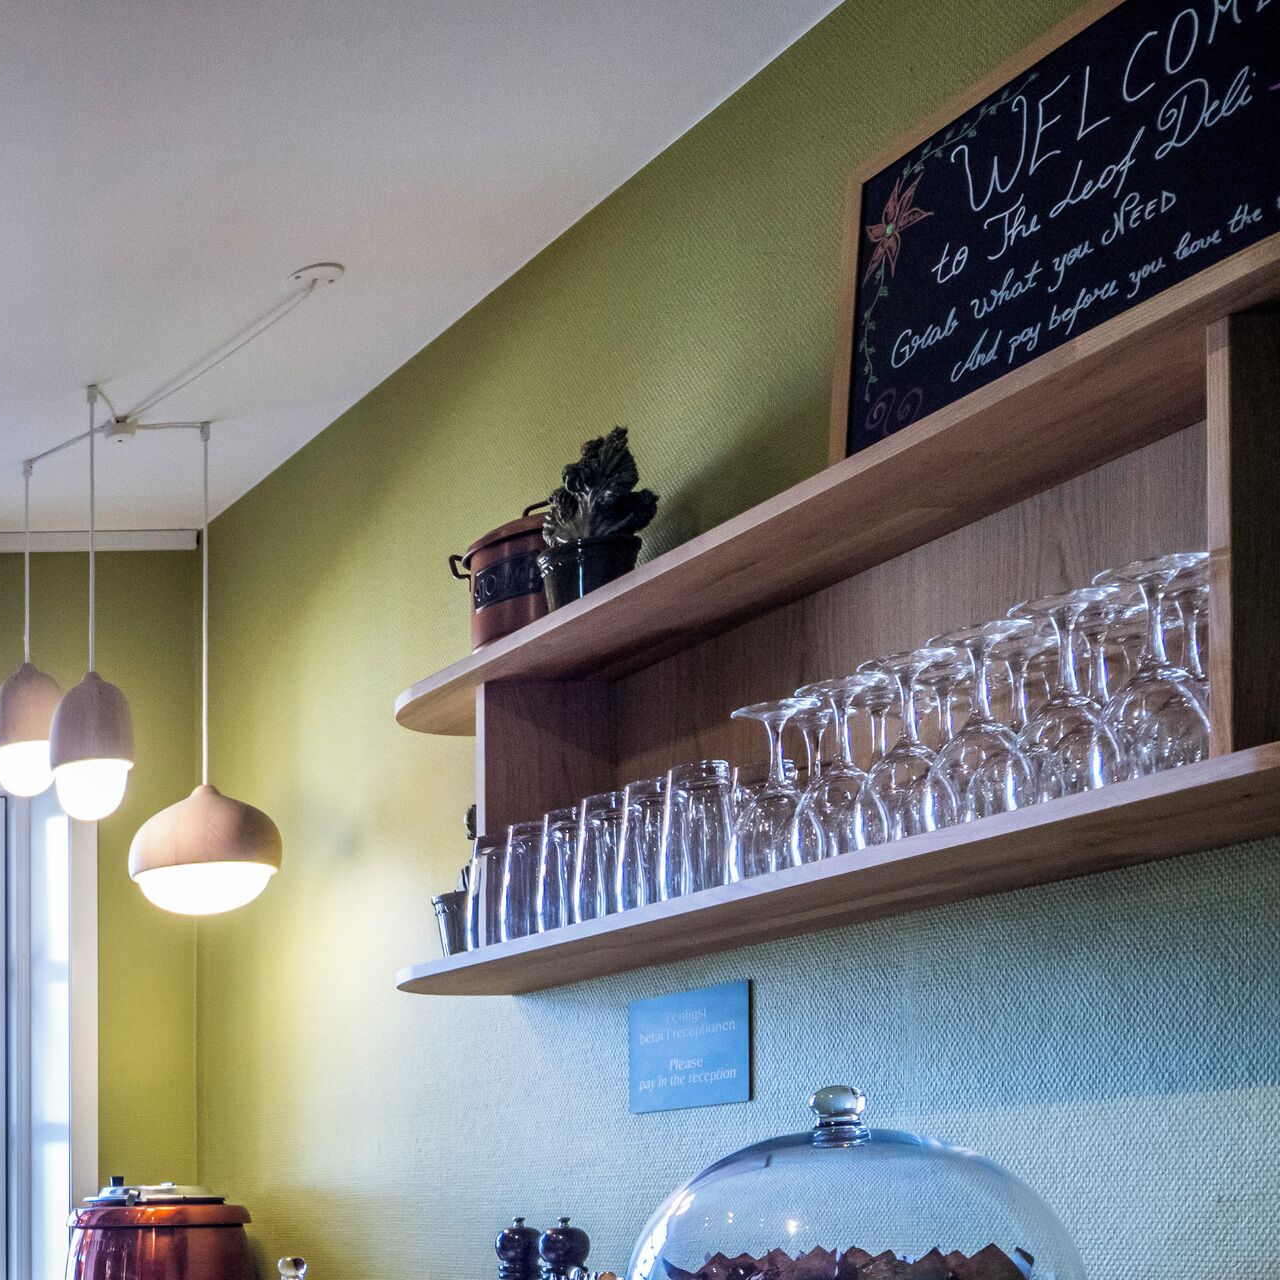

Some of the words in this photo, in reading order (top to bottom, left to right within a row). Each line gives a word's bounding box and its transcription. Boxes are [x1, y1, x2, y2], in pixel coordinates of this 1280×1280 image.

[931, 242, 969, 284] to
[984, 194, 1041, 260] The
[1155, 66, 1256, 160] Deli
[951, 0, 1272, 211] WELCOM
[891, 307, 959, 368] Grab
[1048, 245, 1094, 293] you
[1102, 191, 1177, 245] NEED
[951, 328, 1002, 383] And
[1008, 321, 1041, 364] pay
[1127, 259, 1166, 299] you
[1229, 205, 1263, 232] the
[639, 1030, 663, 1045] betal
[673, 1020, 736, 1038] receptionen
[639, 1079, 655, 1093] pay
[658, 1074, 667, 1088] in
[670, 1074, 686, 1086] the
[688, 1067, 737, 1084] reception
[669, 1057, 704, 1072] Please
